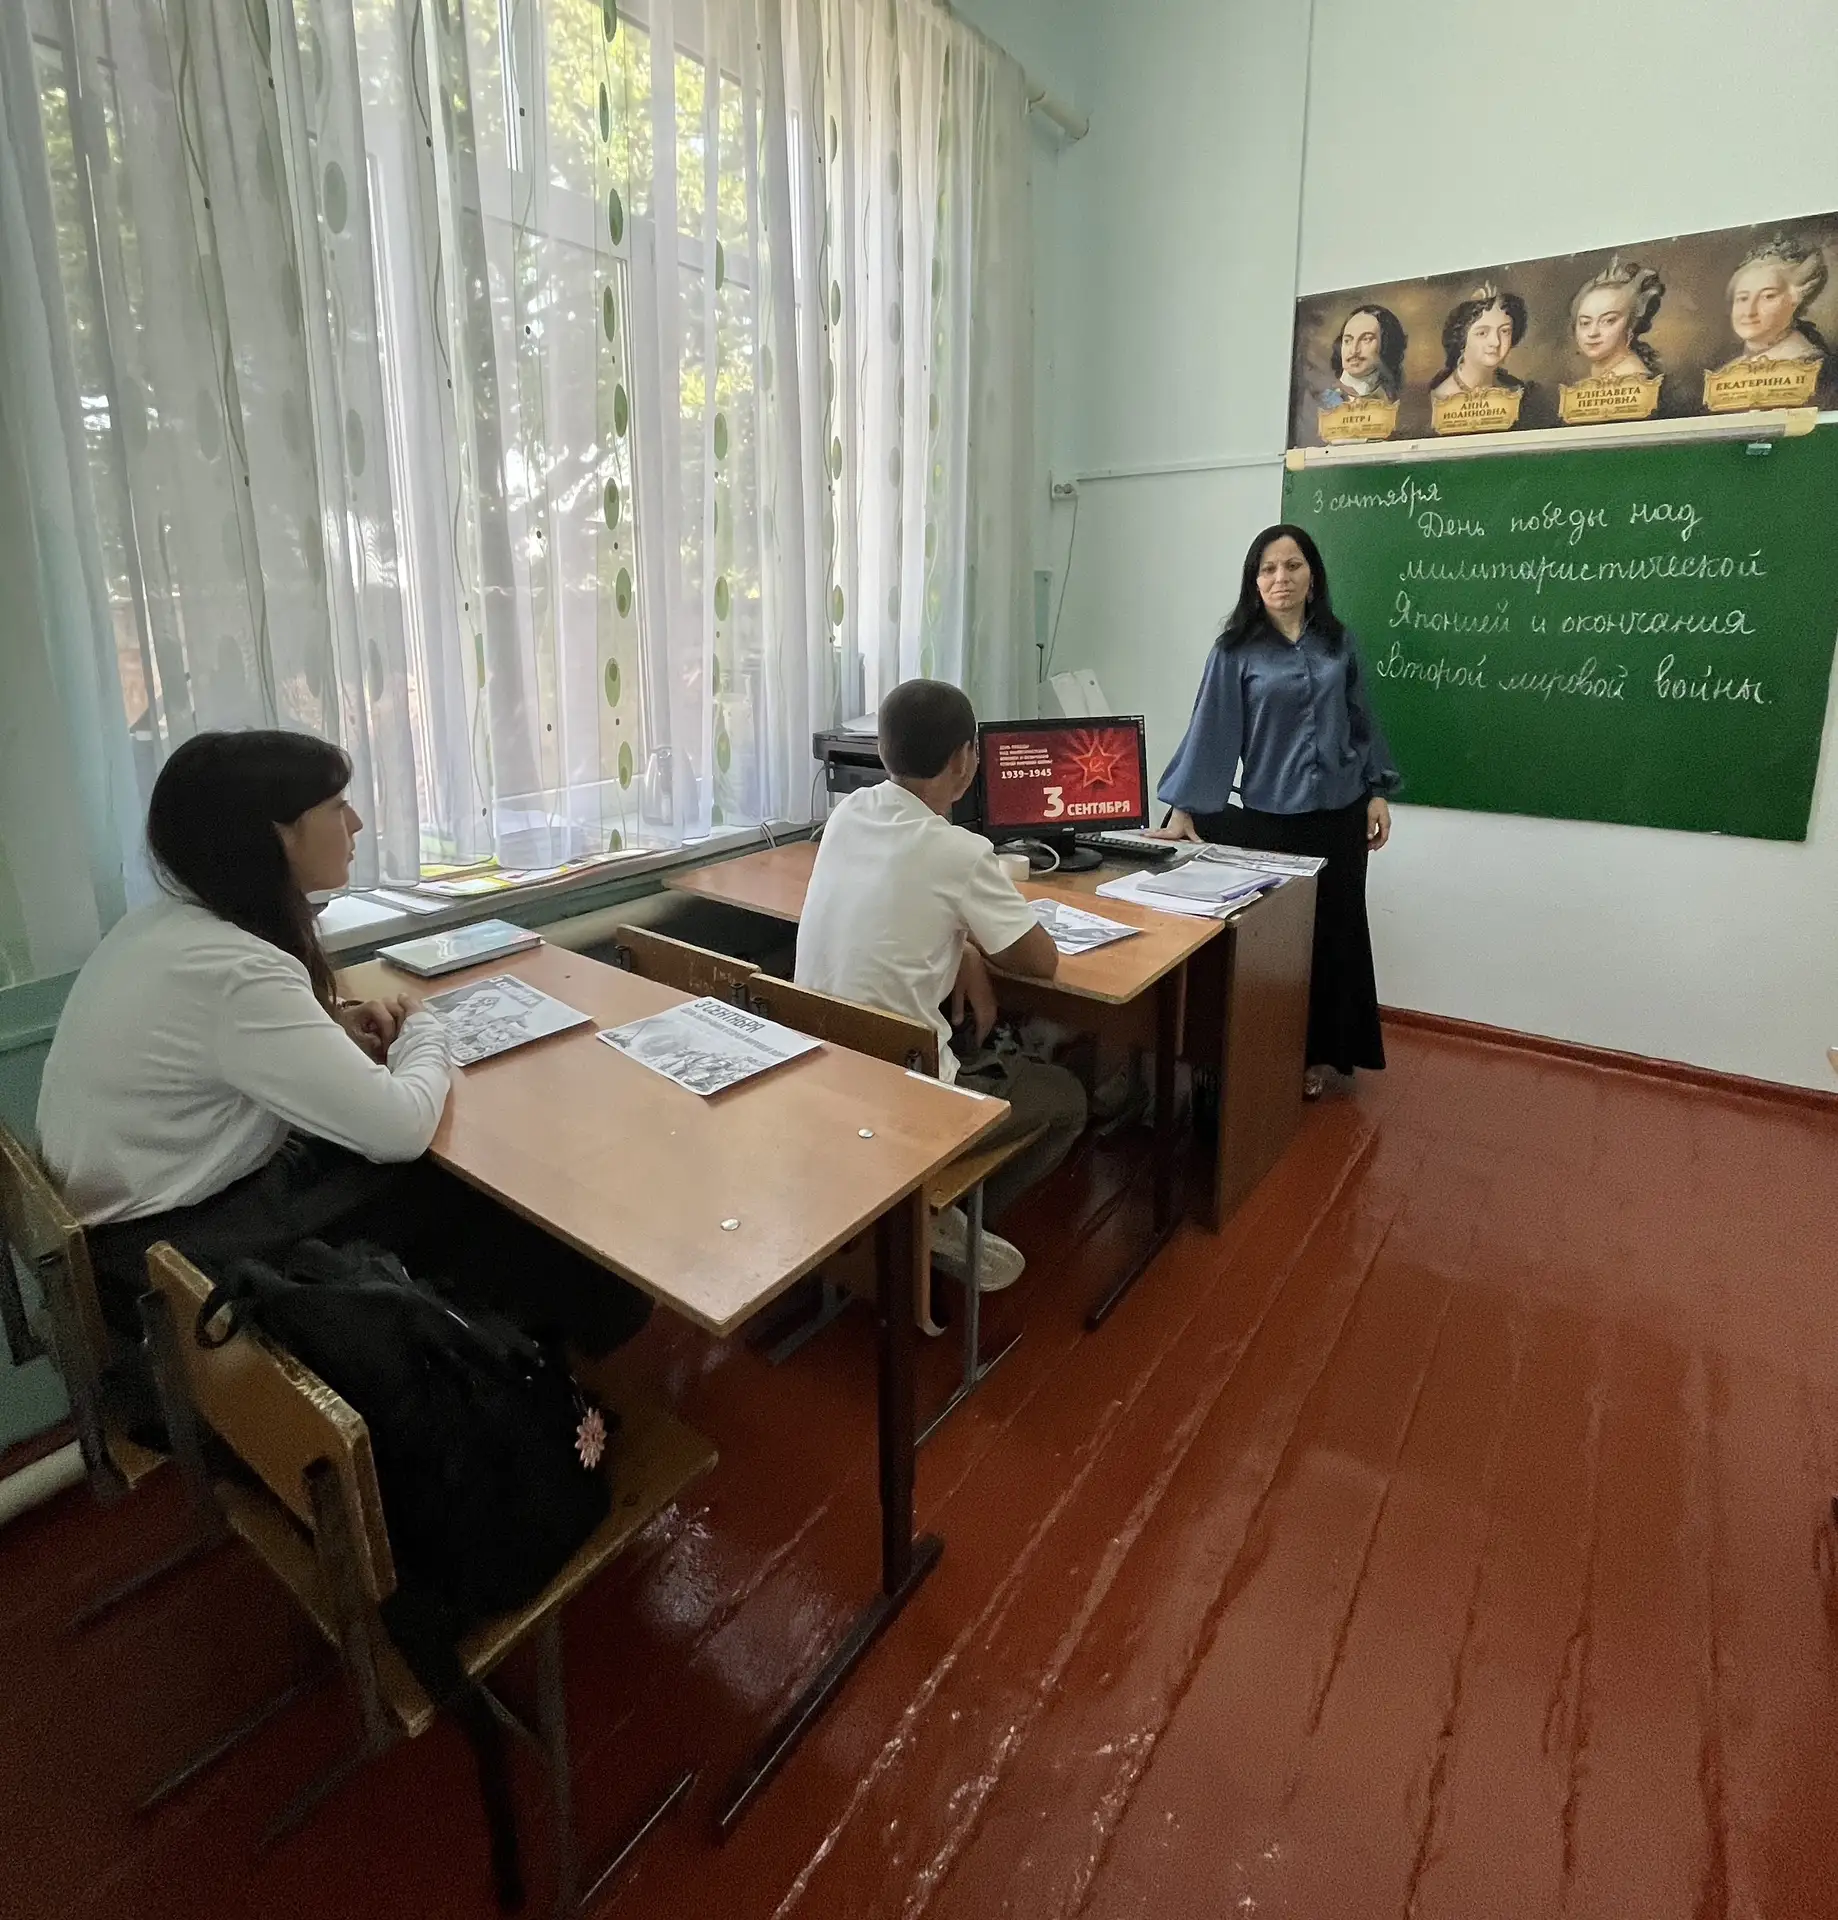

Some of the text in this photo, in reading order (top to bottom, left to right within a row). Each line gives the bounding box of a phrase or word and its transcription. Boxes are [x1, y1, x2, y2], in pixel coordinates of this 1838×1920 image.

[1716, 375, 1806, 391] ЕКАТЕРИНА II
[1576, 386, 1641, 400] ЕЛИЗАВЕТА
[1460, 400, 1490, 411] АННА
[1578, 395, 1638, 408] ПЕТРОВНА
[1342, 415, 1367, 425] ПЕТР
[1443, 408, 1507, 420] ИОАННОВНА
[1312, 475, 1442, 519] 3 сентября
[1418, 500, 1703, 546] День победы над
[1389, 590, 1756, 635] Японией и окончания
[1499, 656, 1628, 701] мировой
[1043, 787, 1131, 817] 3 СЕНТЯБРЯ
[695, 1000, 712, 1008] 3
[702, 1004, 766, 1033] СЕНТЯБРЯ
